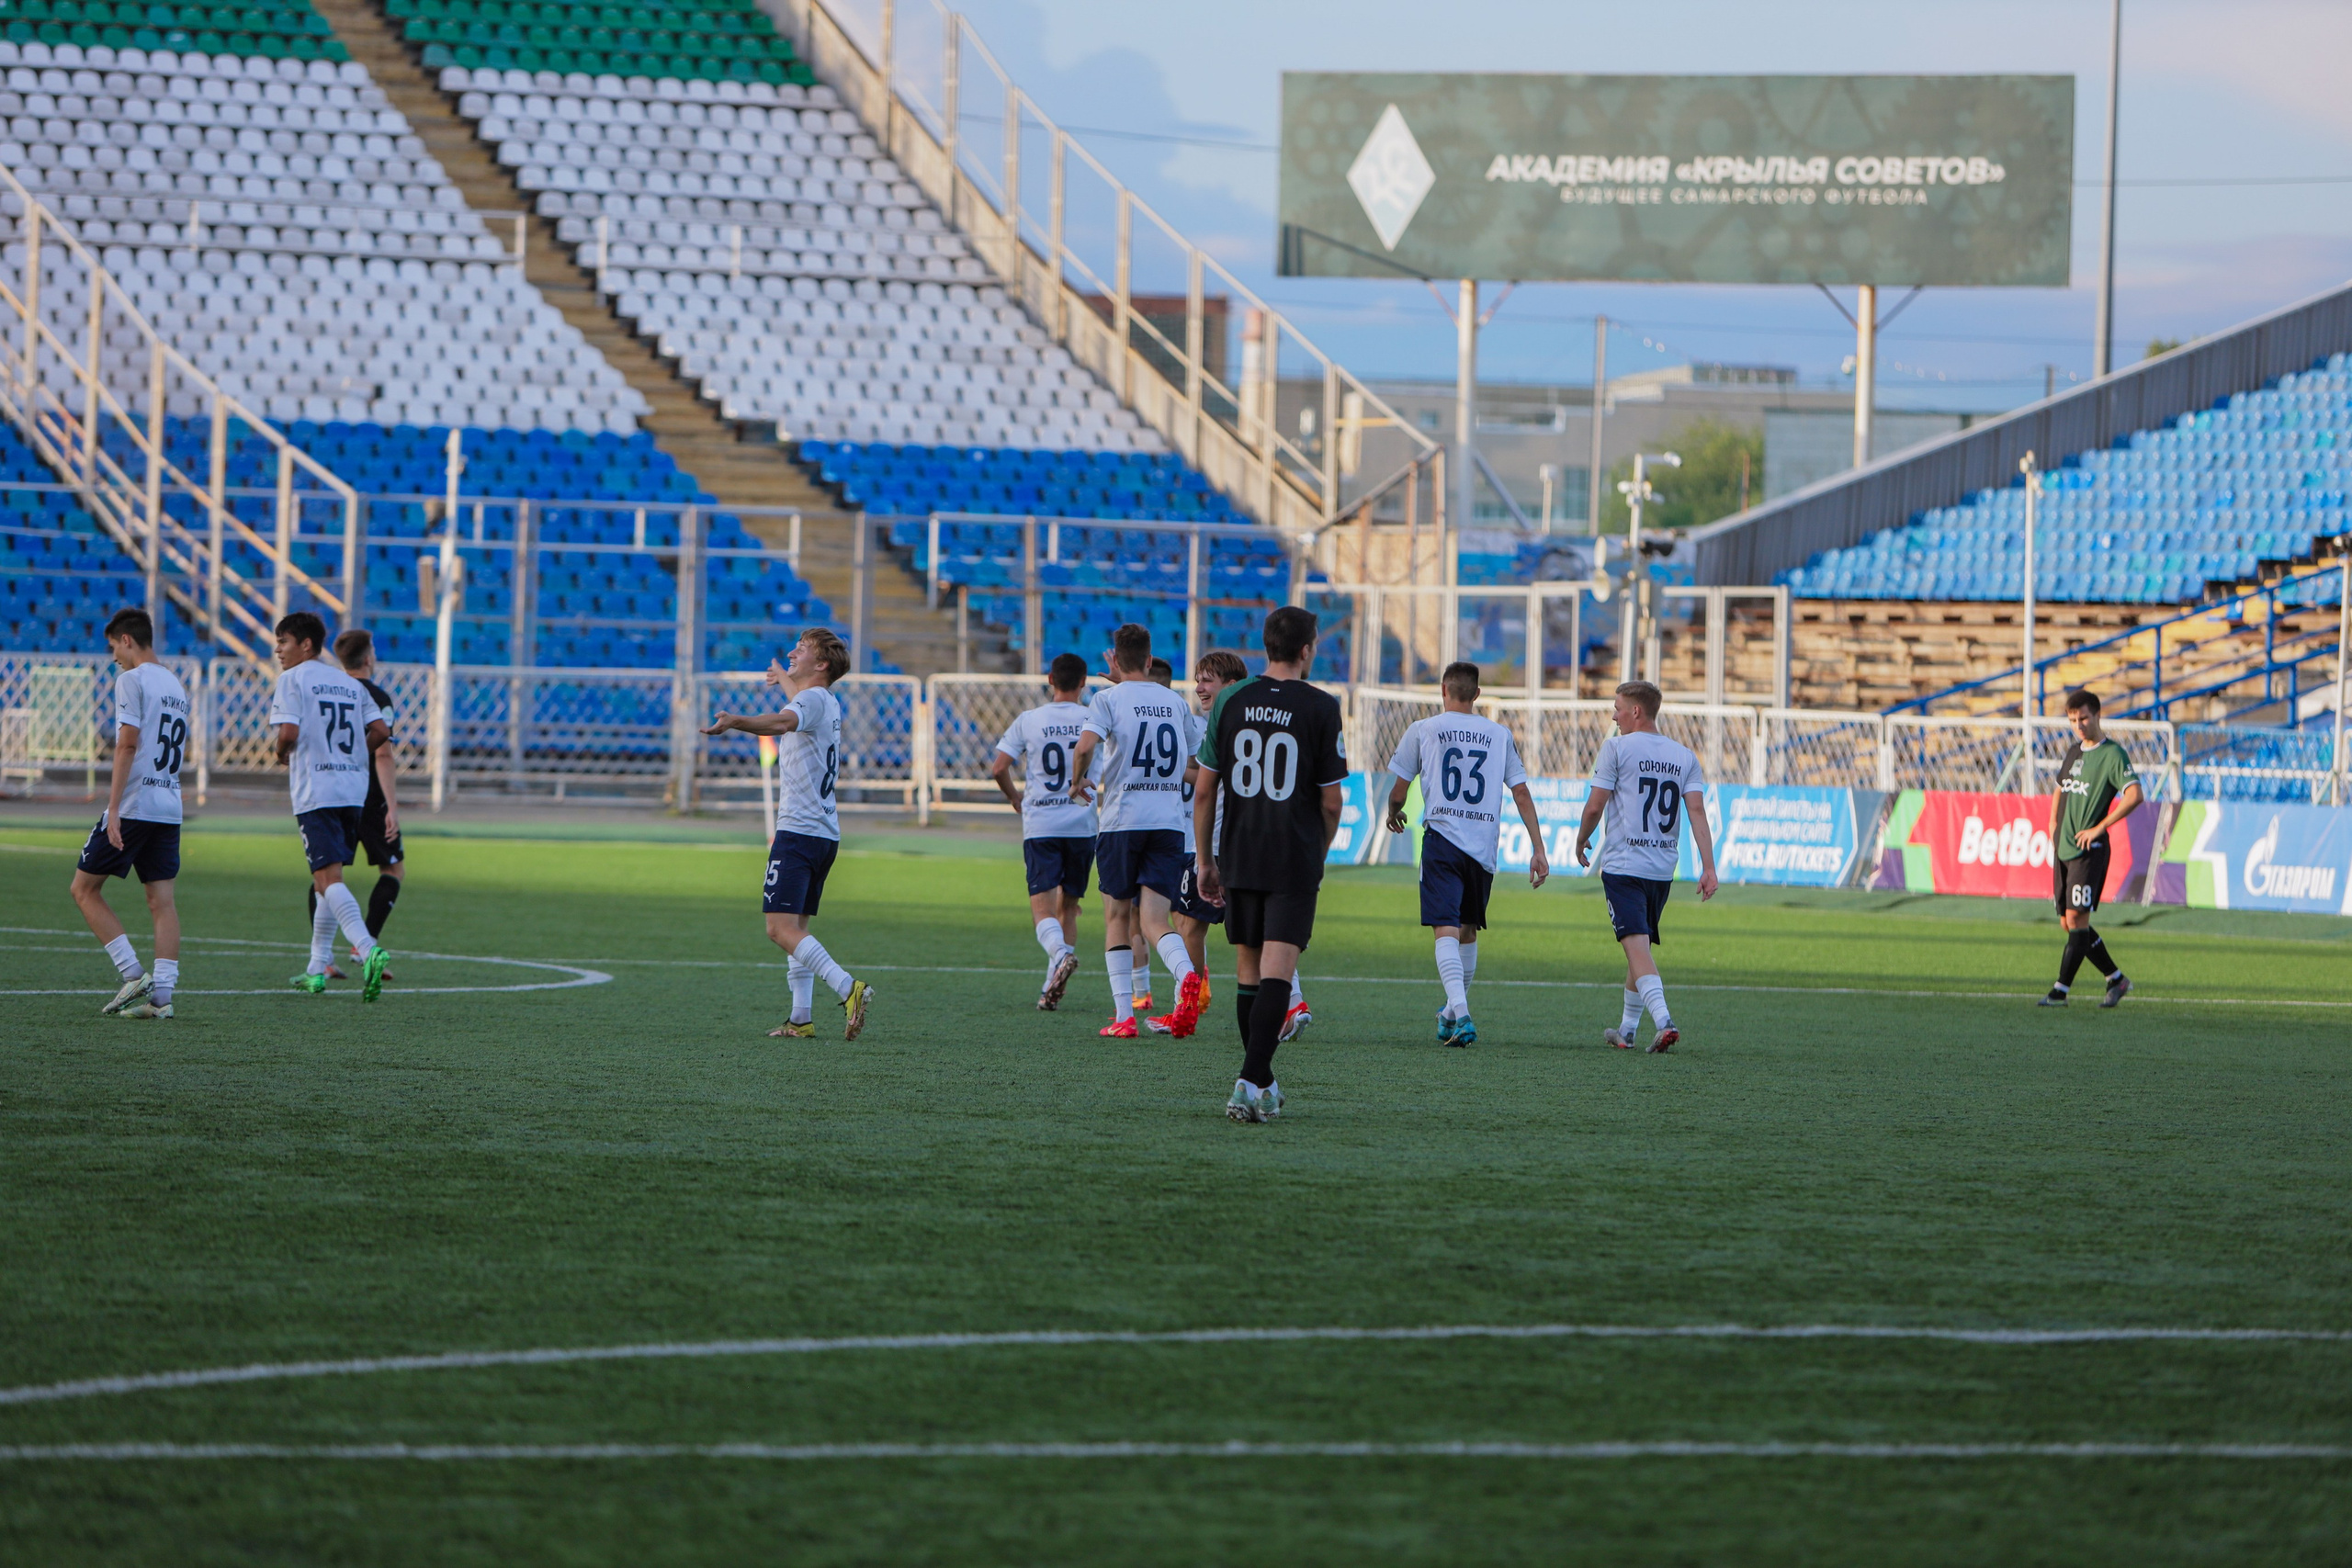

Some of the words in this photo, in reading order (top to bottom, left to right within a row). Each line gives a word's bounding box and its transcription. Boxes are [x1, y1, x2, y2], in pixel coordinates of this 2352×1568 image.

[1485, 154, 1670, 186] АКАДЕМИЯ
[1674, 155, 1830, 185] «КРЫЛЬЯ
[1834, 156, 2007, 185] СОВЕТОВ»
[1560, 186, 1663, 206] БУДУЩЕЕ
[1669, 186, 1817, 206] САМАРСКОГО
[1823, 187, 1928, 206] ФУТБОЛА
[1133, 705, 1172, 718] РЯБЦЕВ
[1245, 706, 1293, 727] МОСИН
[318, 700, 355, 754] 75
[1042, 725, 1081, 738] УРАЗАЕ
[1437, 728, 1492, 749] МУТОВКИН
[153, 712, 187, 774] 58
[1131, 720, 1178, 778] 49
[1231, 728, 1299, 802] 80
[1441, 746, 1487, 805] 63
[1123, 783, 1159, 792] САМАРСКАЯ
[1160, 783, 1182, 792] ОБЛАС
[1465, 810, 1495, 823] ОБЛАСТЬ
[1638, 776, 1680, 834] 79
[1958, 816, 2054, 868] BetBo
[2071, 884, 2092, 908] 68
